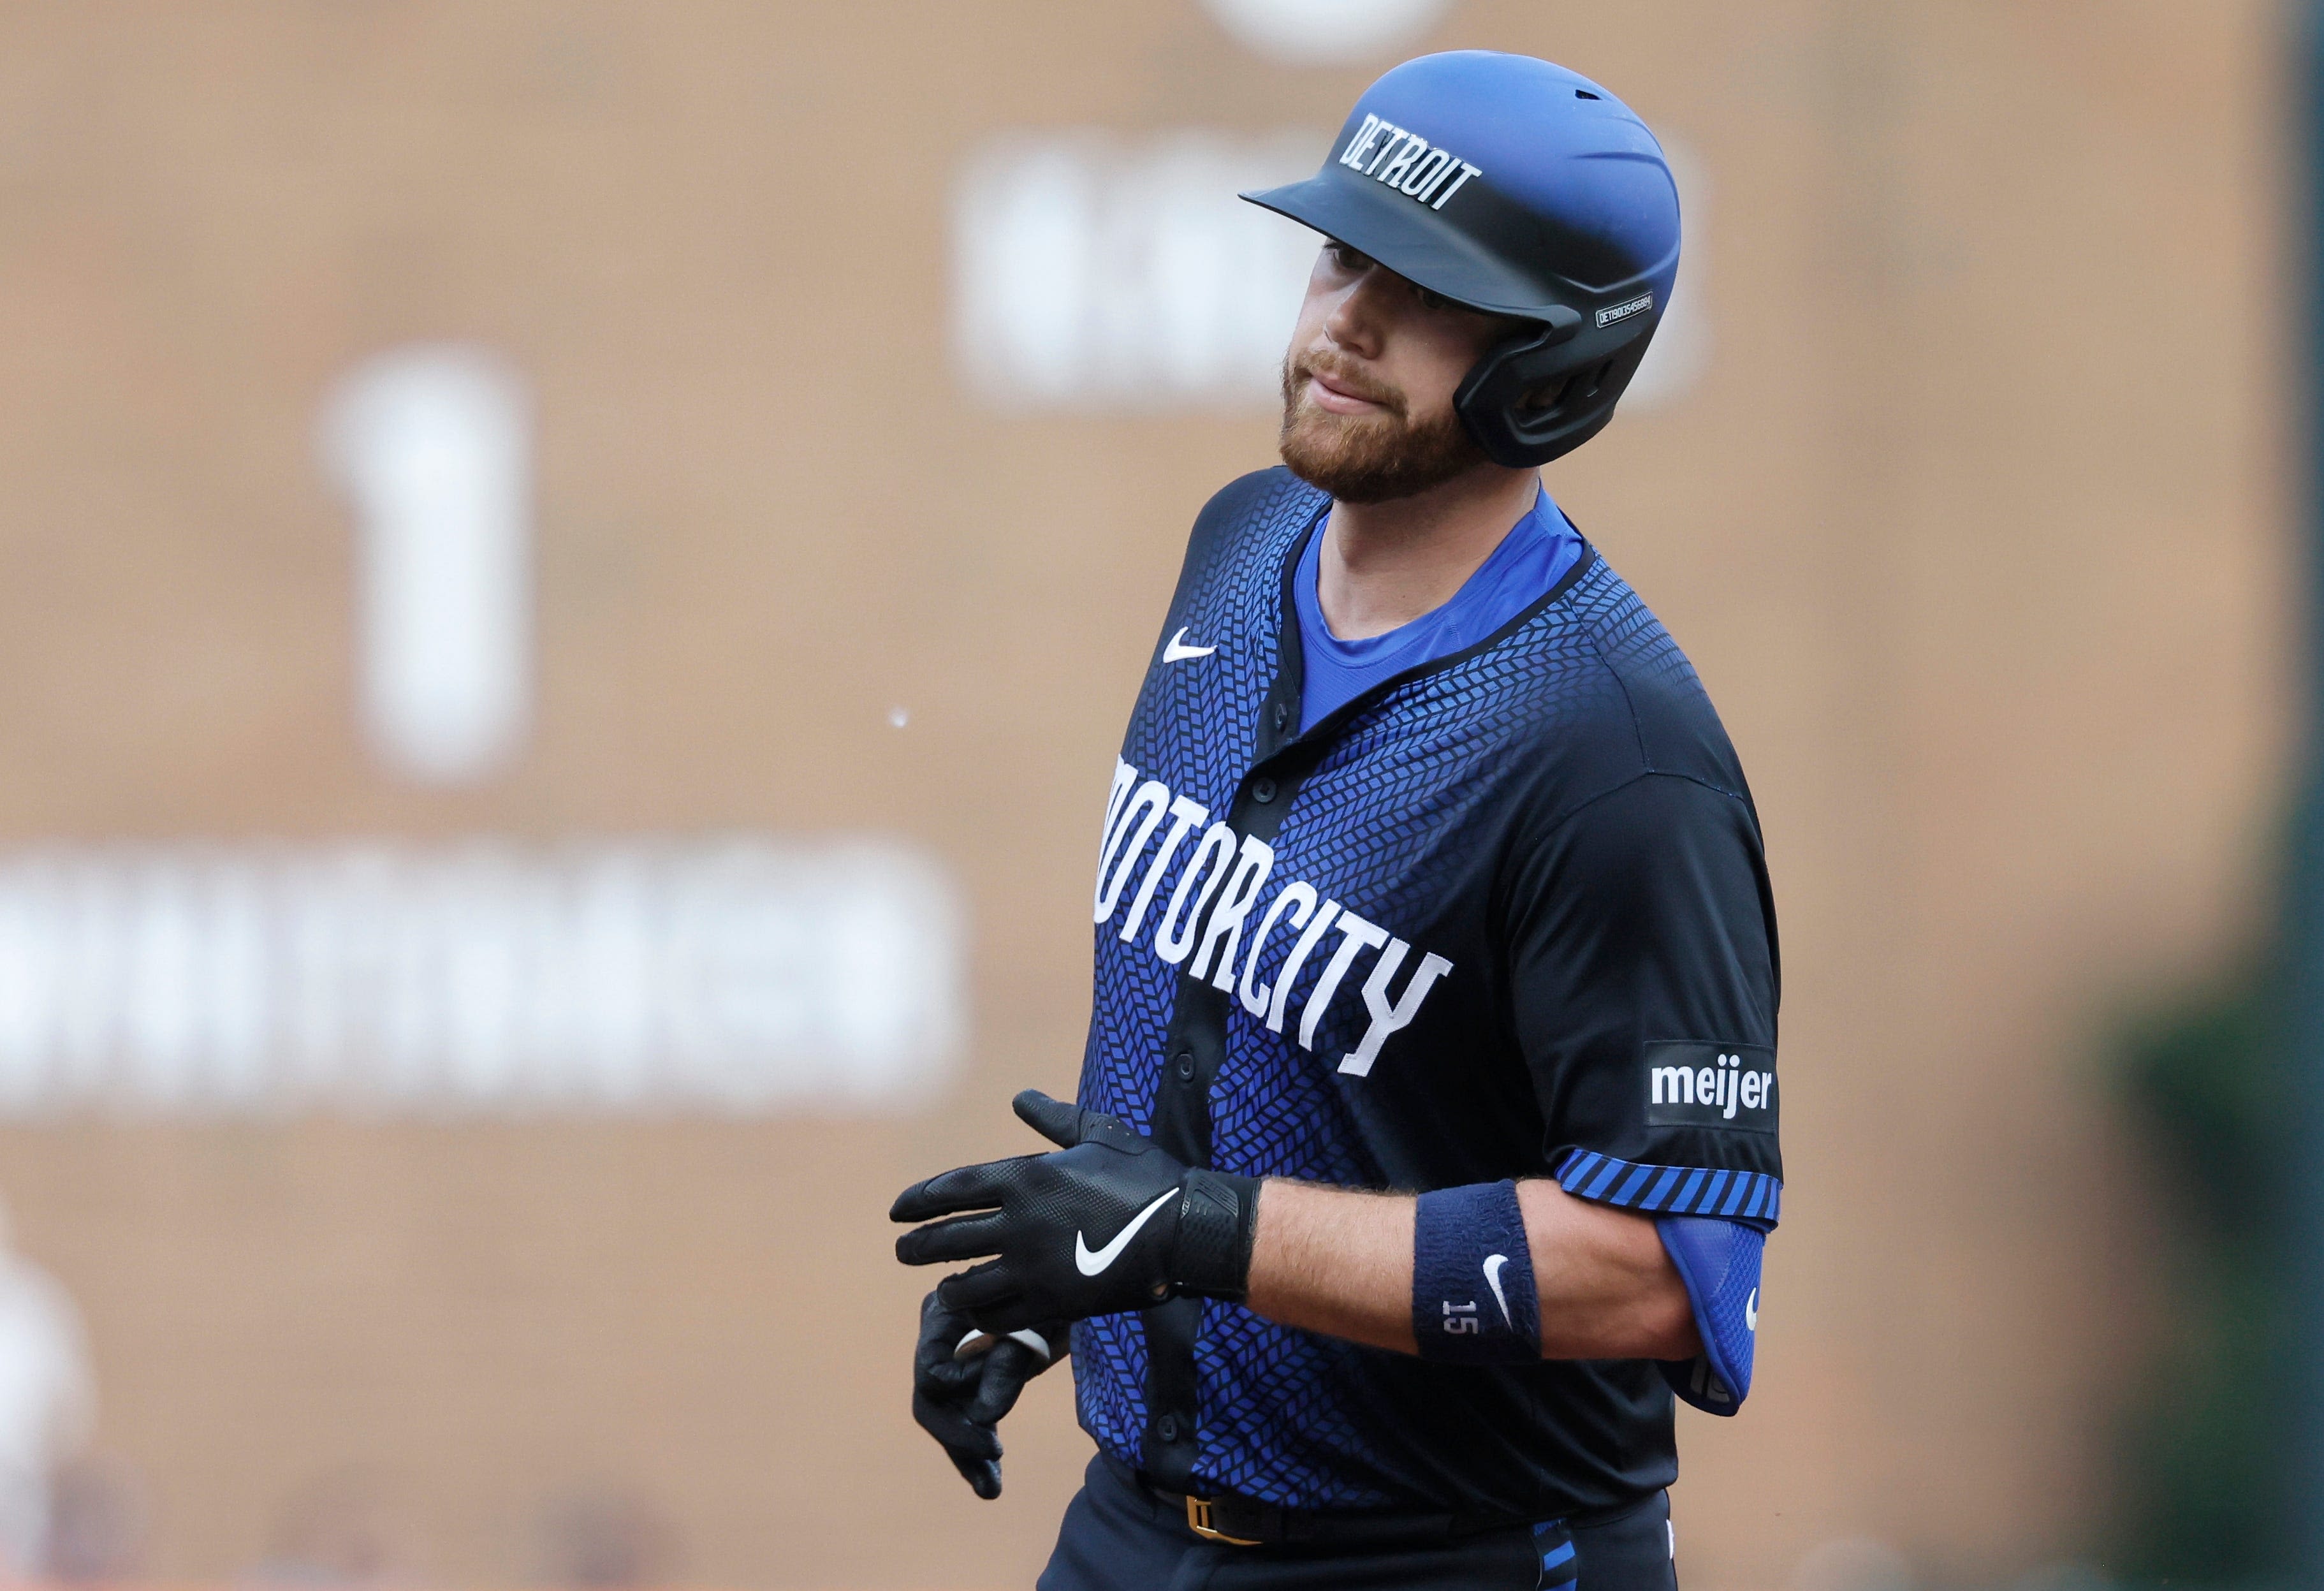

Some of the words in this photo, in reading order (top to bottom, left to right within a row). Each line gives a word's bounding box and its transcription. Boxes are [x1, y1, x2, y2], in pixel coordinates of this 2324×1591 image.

[1340, 113, 1482, 210] DETROIT
[1651, 1053, 1772, 1119] meijer
[1443, 1300, 1478, 1334] 15
